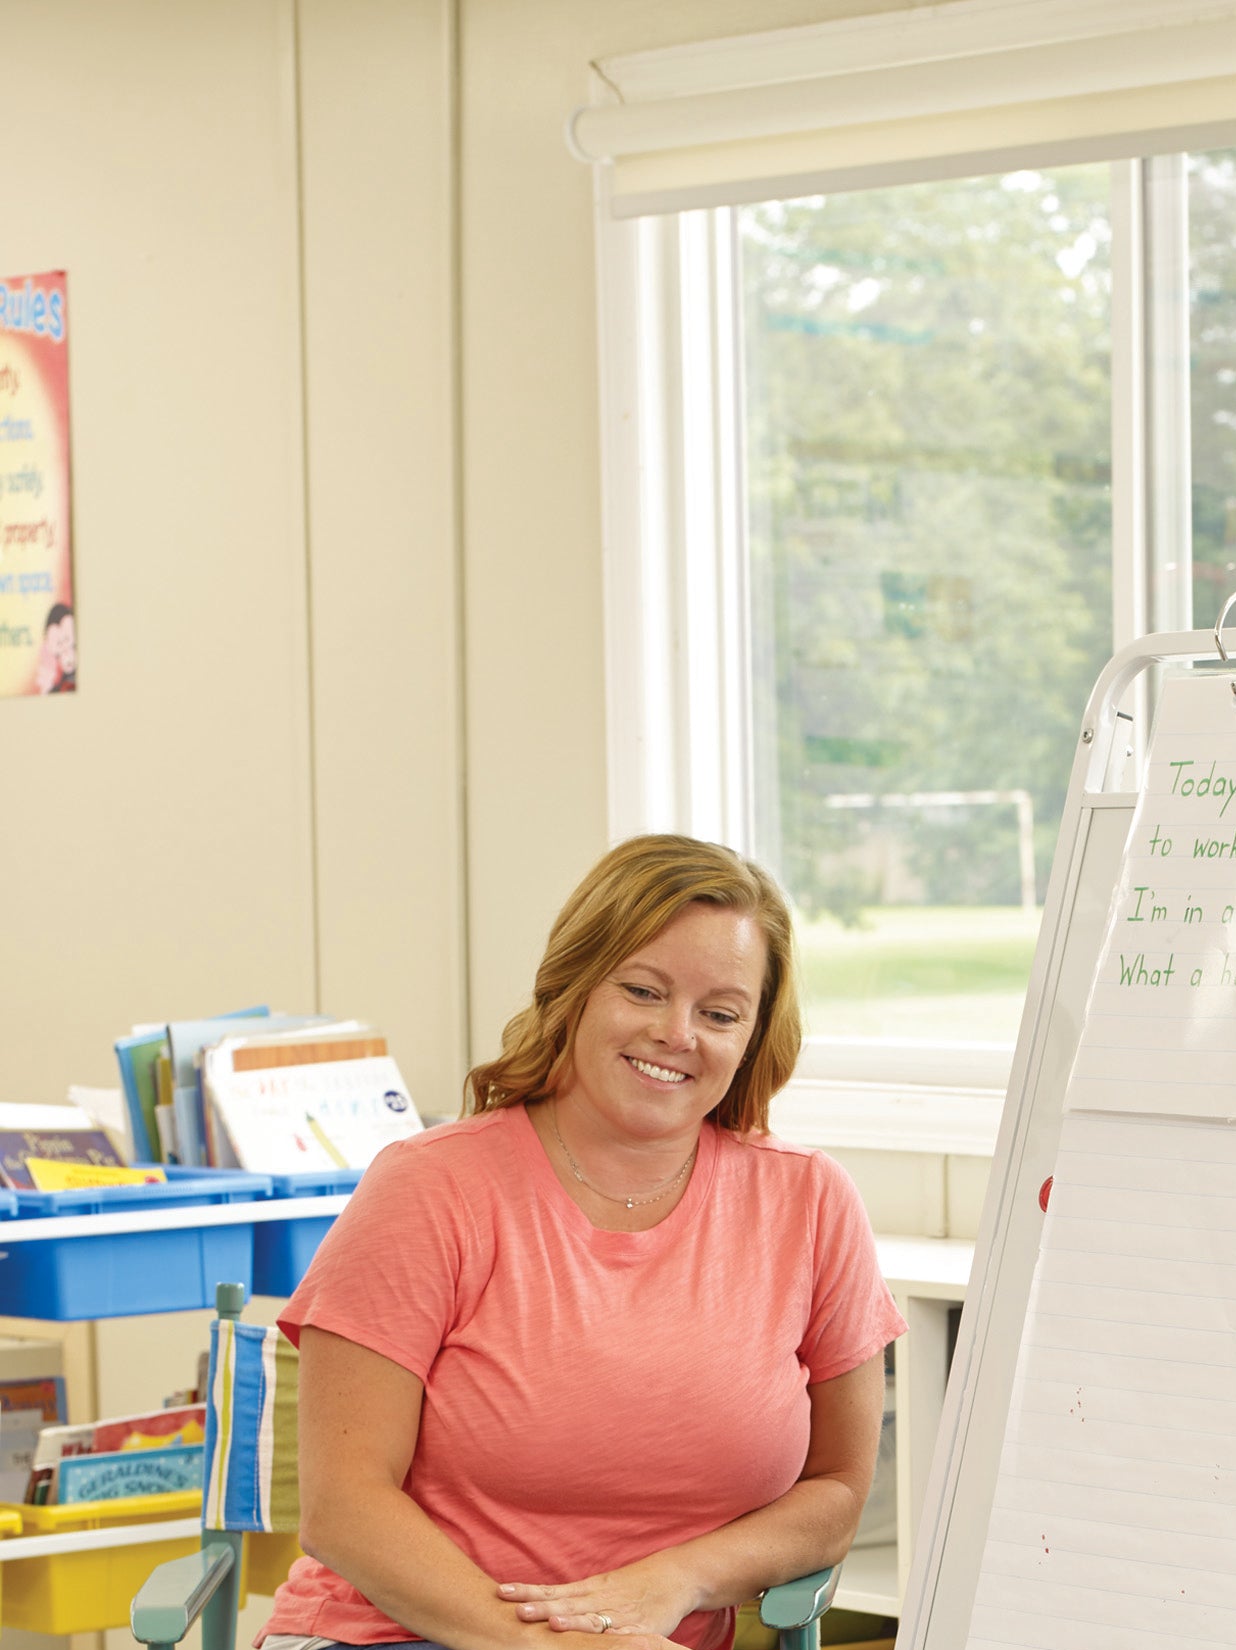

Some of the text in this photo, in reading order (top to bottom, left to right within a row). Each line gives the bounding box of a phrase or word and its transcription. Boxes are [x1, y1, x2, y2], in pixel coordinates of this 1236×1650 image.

[1149, 824, 1173, 857] to
[1183, 893, 1203, 924] in
[1221, 904, 1235, 923] a
[1118, 952, 1176, 987] What
[1189, 968, 1203, 987] a
